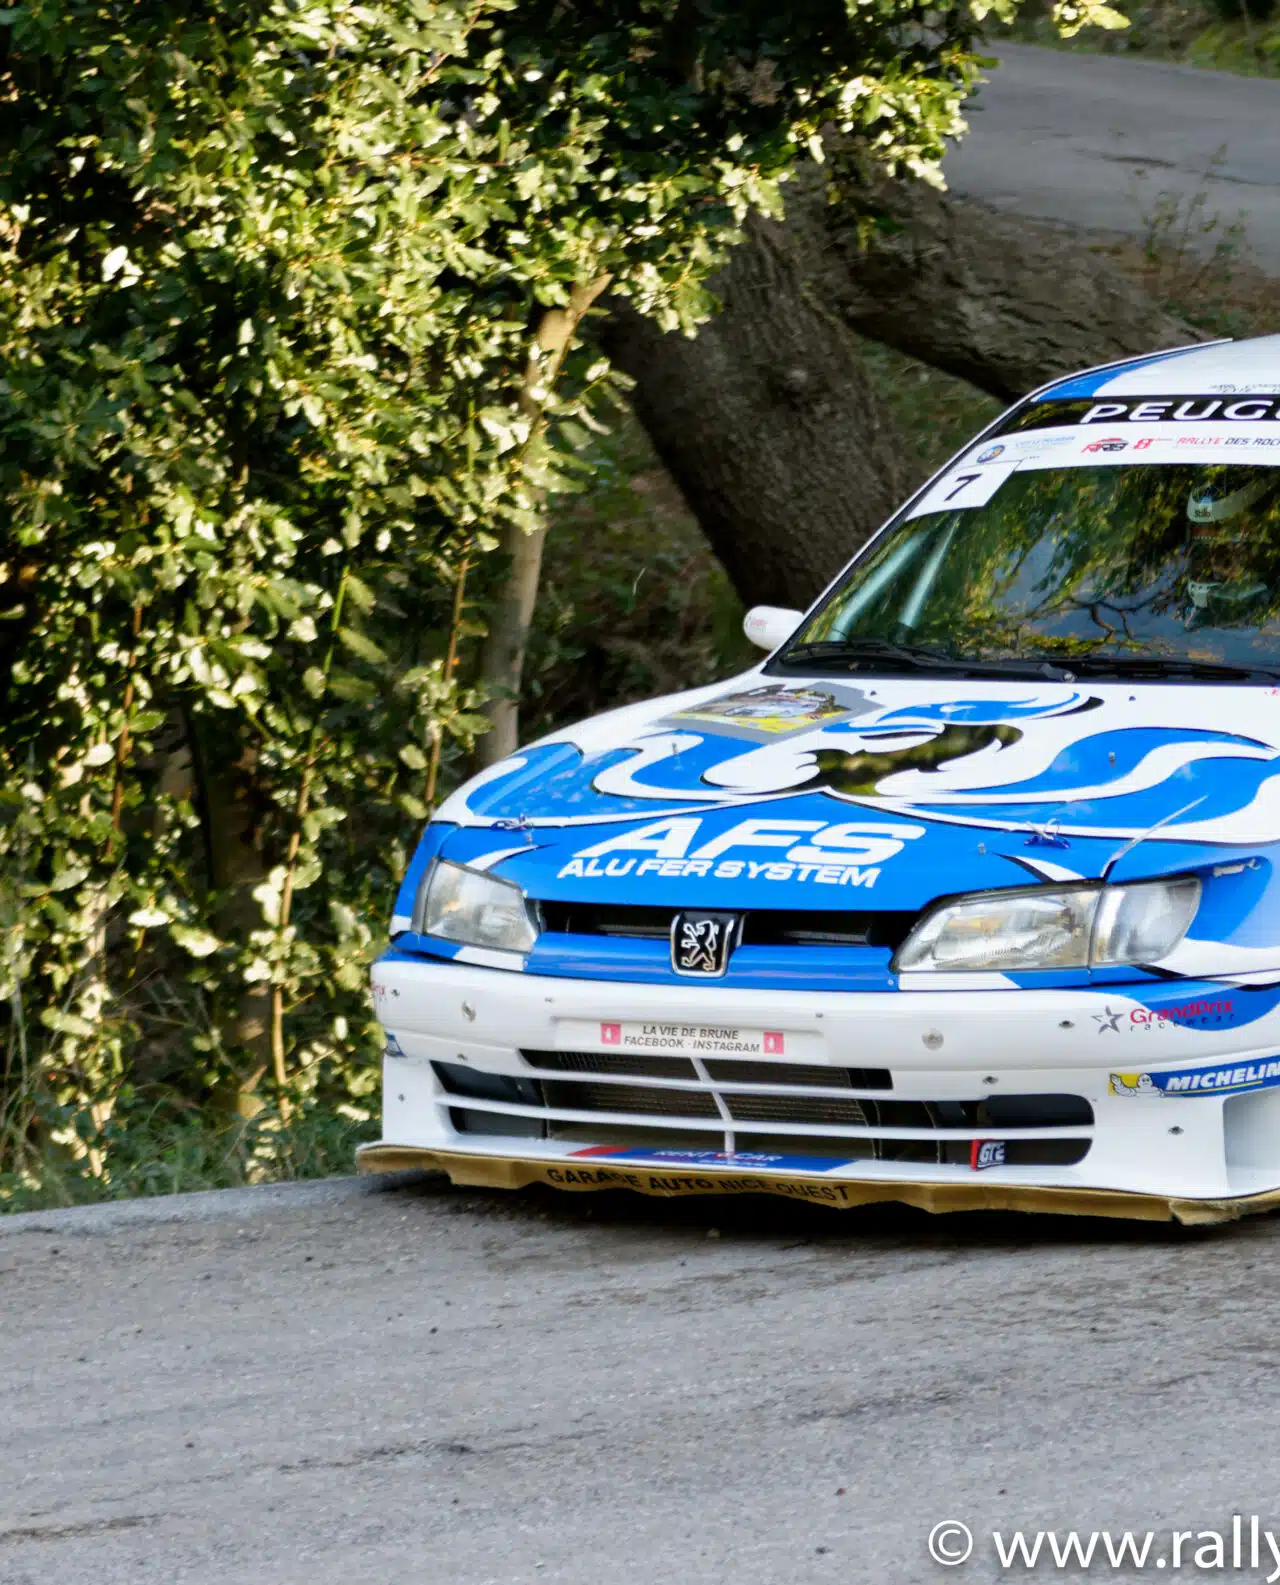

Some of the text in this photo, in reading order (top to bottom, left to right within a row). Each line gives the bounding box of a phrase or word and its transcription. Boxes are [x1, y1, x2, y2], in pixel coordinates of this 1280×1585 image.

[1176, 436, 1224, 446] RALLYE
[1224, 437, 1250, 446] DES
[944, 473, 983, 502] 7
[574, 817, 927, 867] AFS
[556, 857, 881, 889] ALU FER SYSTEM
[1130, 999, 1234, 1024] GrandPrix
[624, 1035, 685, 1049] FACEBOOK
[693, 1040, 760, 1053] INSTAGRAM
[643, 1025, 740, 1041] LA VIE DE BRUNE
[650, 1176, 714, 1192] AUTO
[775, 1182, 849, 1201] OUEST
